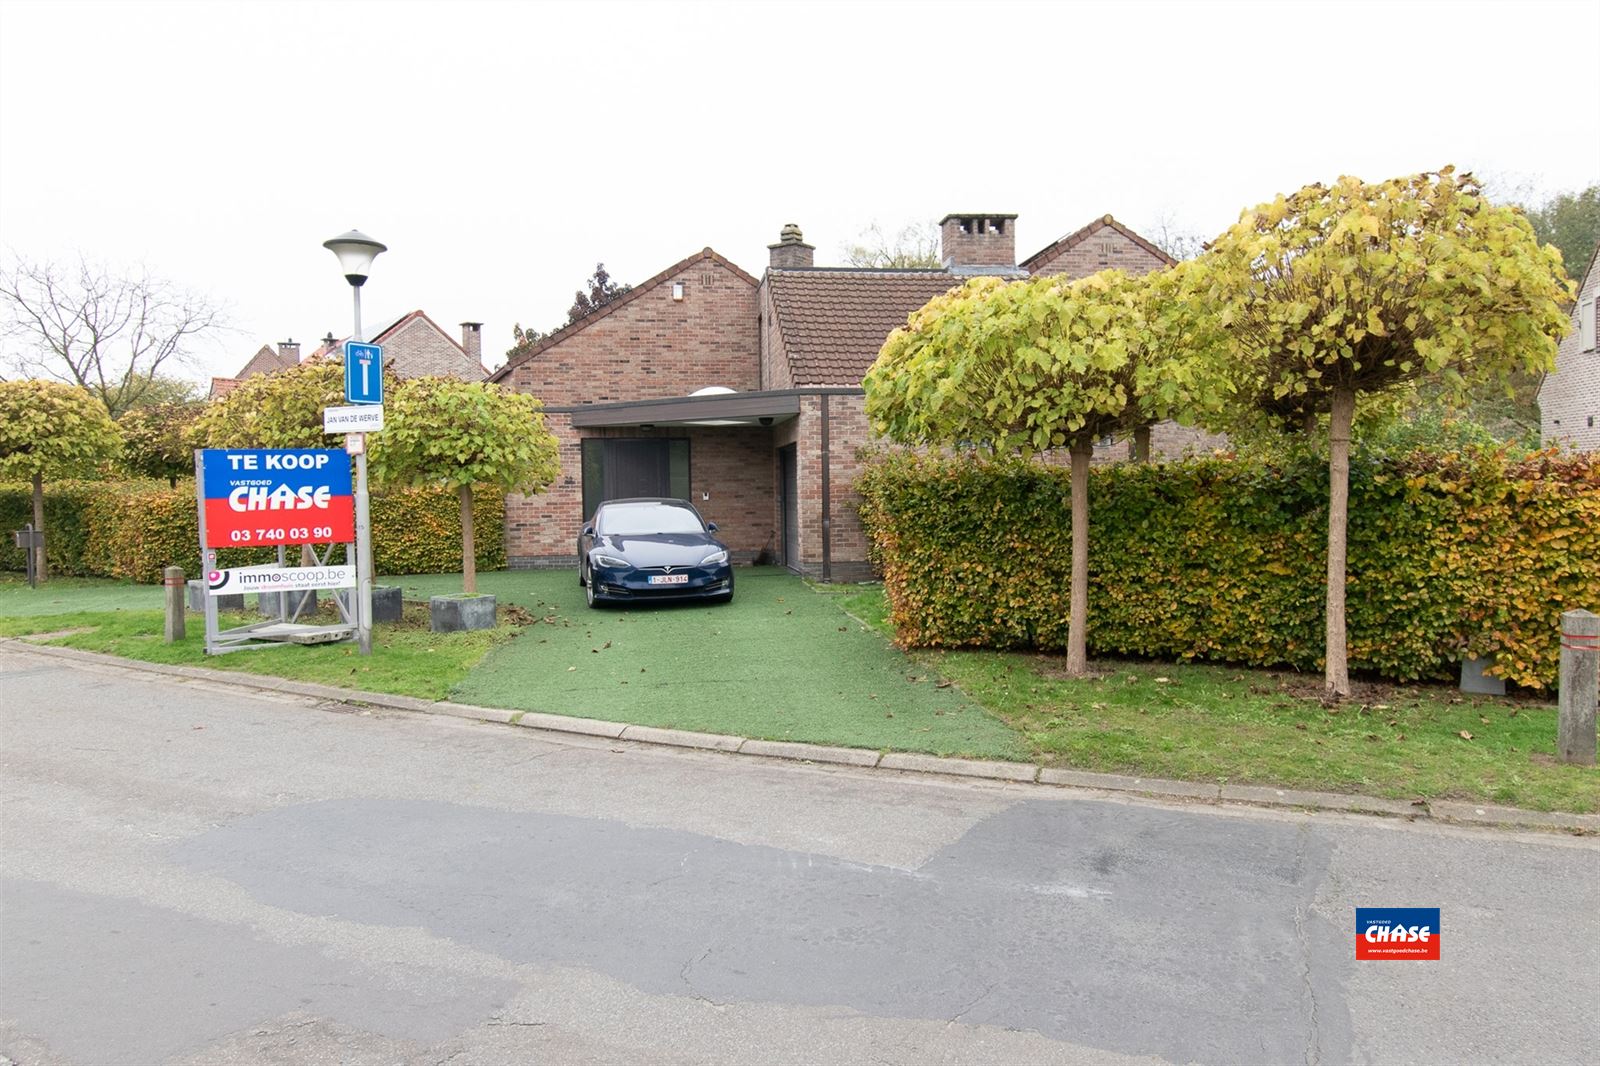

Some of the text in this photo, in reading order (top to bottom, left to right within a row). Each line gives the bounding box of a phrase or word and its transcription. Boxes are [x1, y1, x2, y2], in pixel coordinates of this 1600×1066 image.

[327, 413, 379, 424] JAN VAN DE WERVE
[227, 454, 329, 470] TE KOOP
[229, 484, 331, 512] CHASE
[230, 527, 332, 541] 03 740 03 90
[239, 568, 346, 584] immoscoop.be
